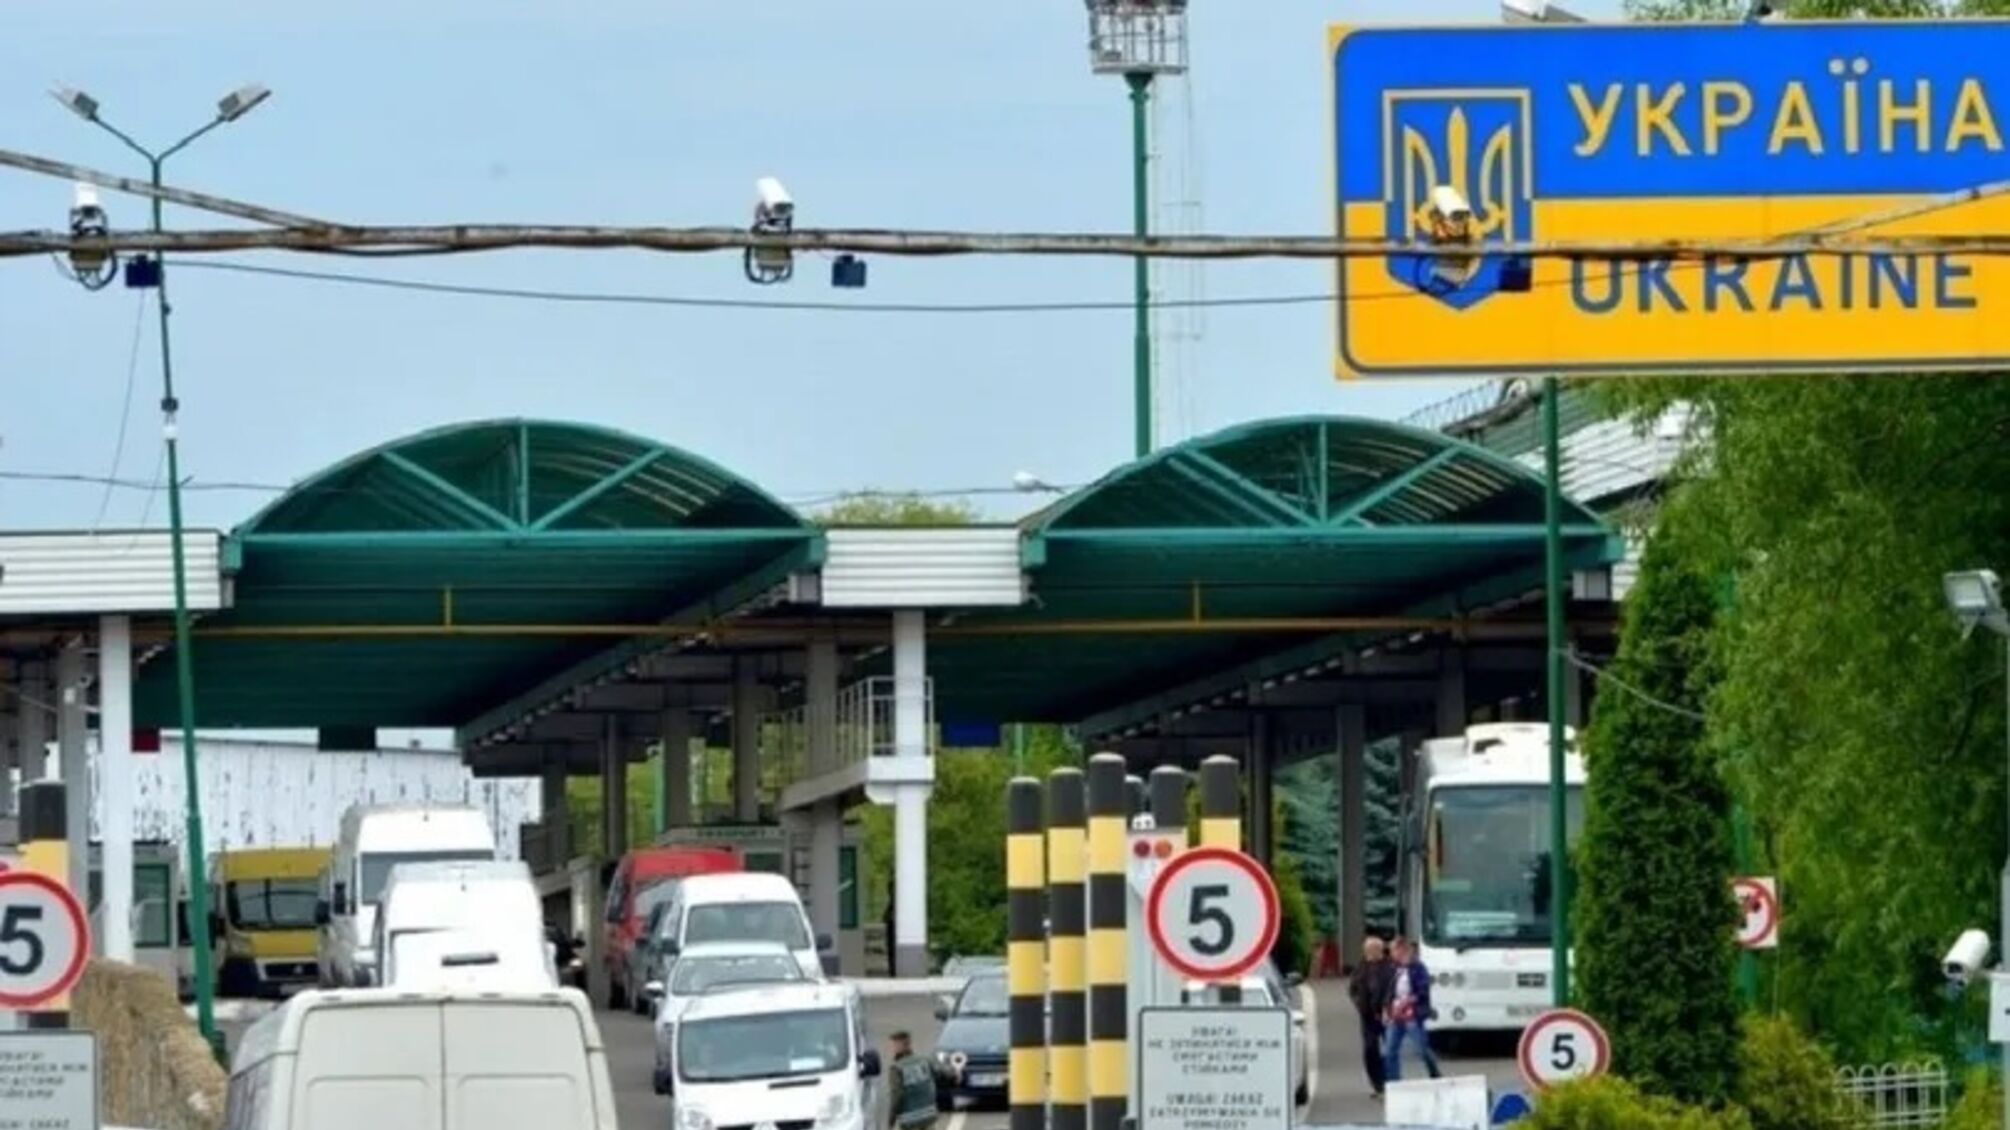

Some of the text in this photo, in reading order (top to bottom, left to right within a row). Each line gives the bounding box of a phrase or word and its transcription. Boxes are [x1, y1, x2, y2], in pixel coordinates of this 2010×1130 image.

[1568, 57, 2003, 157] УКРАЇНА
[1569, 252, 1978, 313] UKRAINE
[0, 905, 44, 977] 5
[1189, 884, 1234, 956] 5
[1552, 1033, 1575, 1070] 5
